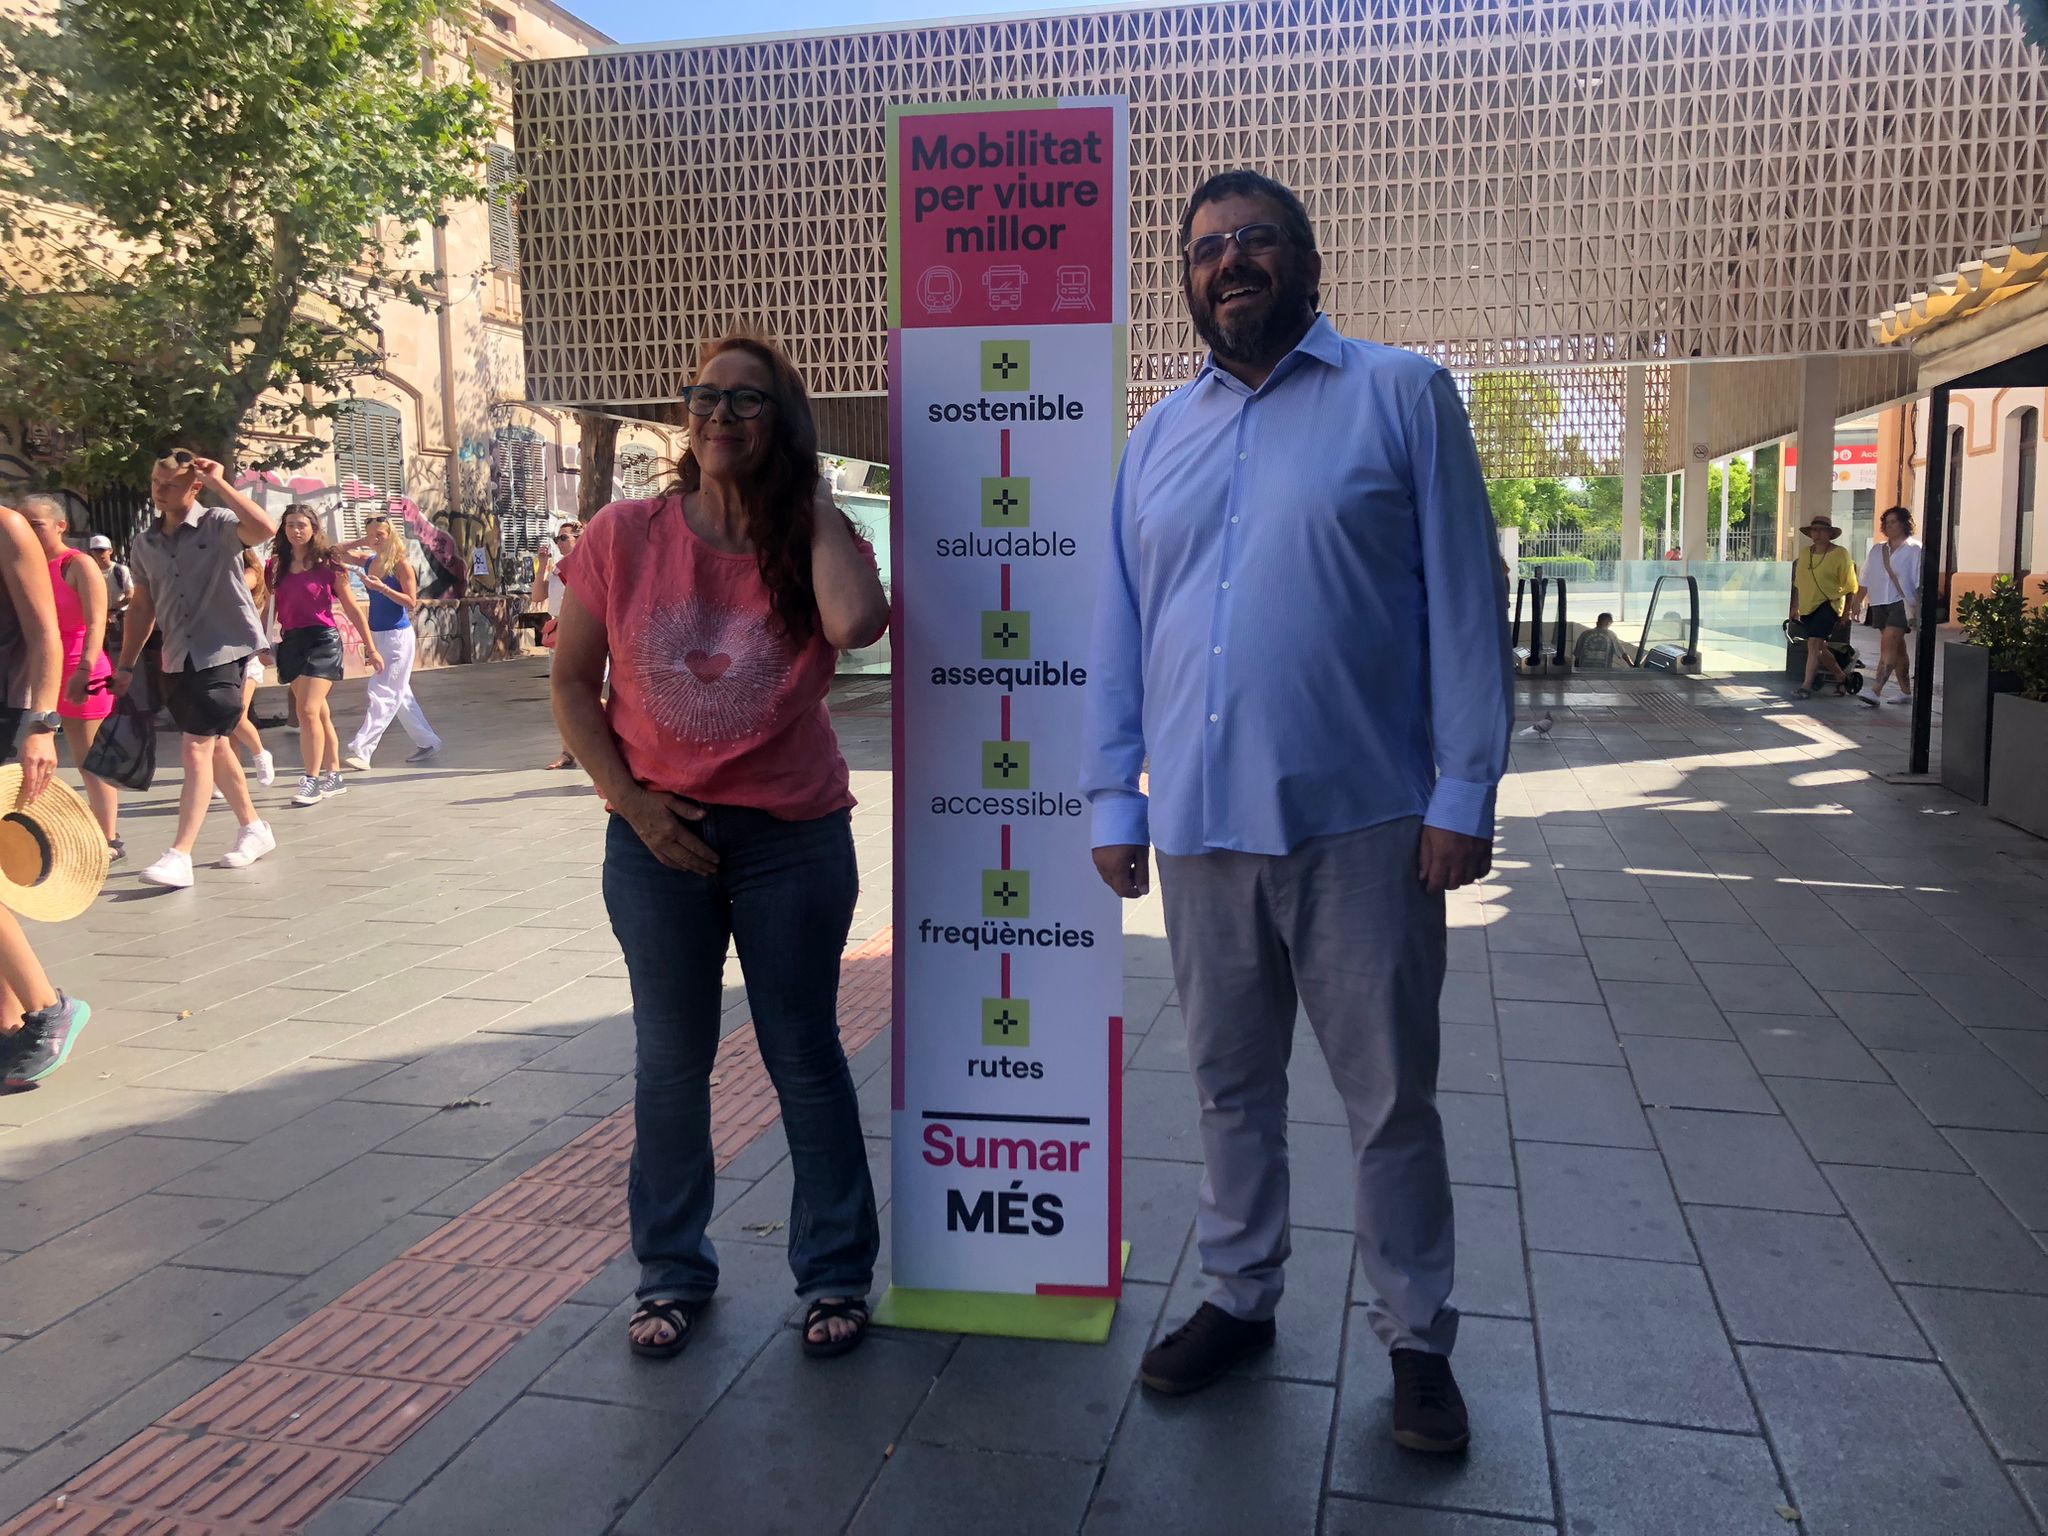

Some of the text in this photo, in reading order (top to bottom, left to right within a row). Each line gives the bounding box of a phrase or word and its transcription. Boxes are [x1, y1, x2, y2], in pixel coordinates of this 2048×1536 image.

[911, 129, 1102, 171] Mobilitat
[914, 171, 1098, 222] per viure
[945, 215, 1066, 253] millor
[928, 394, 1084, 422] sostenible
[936, 531, 1076, 557] saludable
[931, 660, 1087, 692] assequible
[931, 792, 1082, 817] accessible
[918, 918, 1094, 951] freqüències
[968, 1055, 1044, 1080] rutes
[922, 1124, 1091, 1172] Sumar
[946, 1180, 1065, 1237] MÉS
